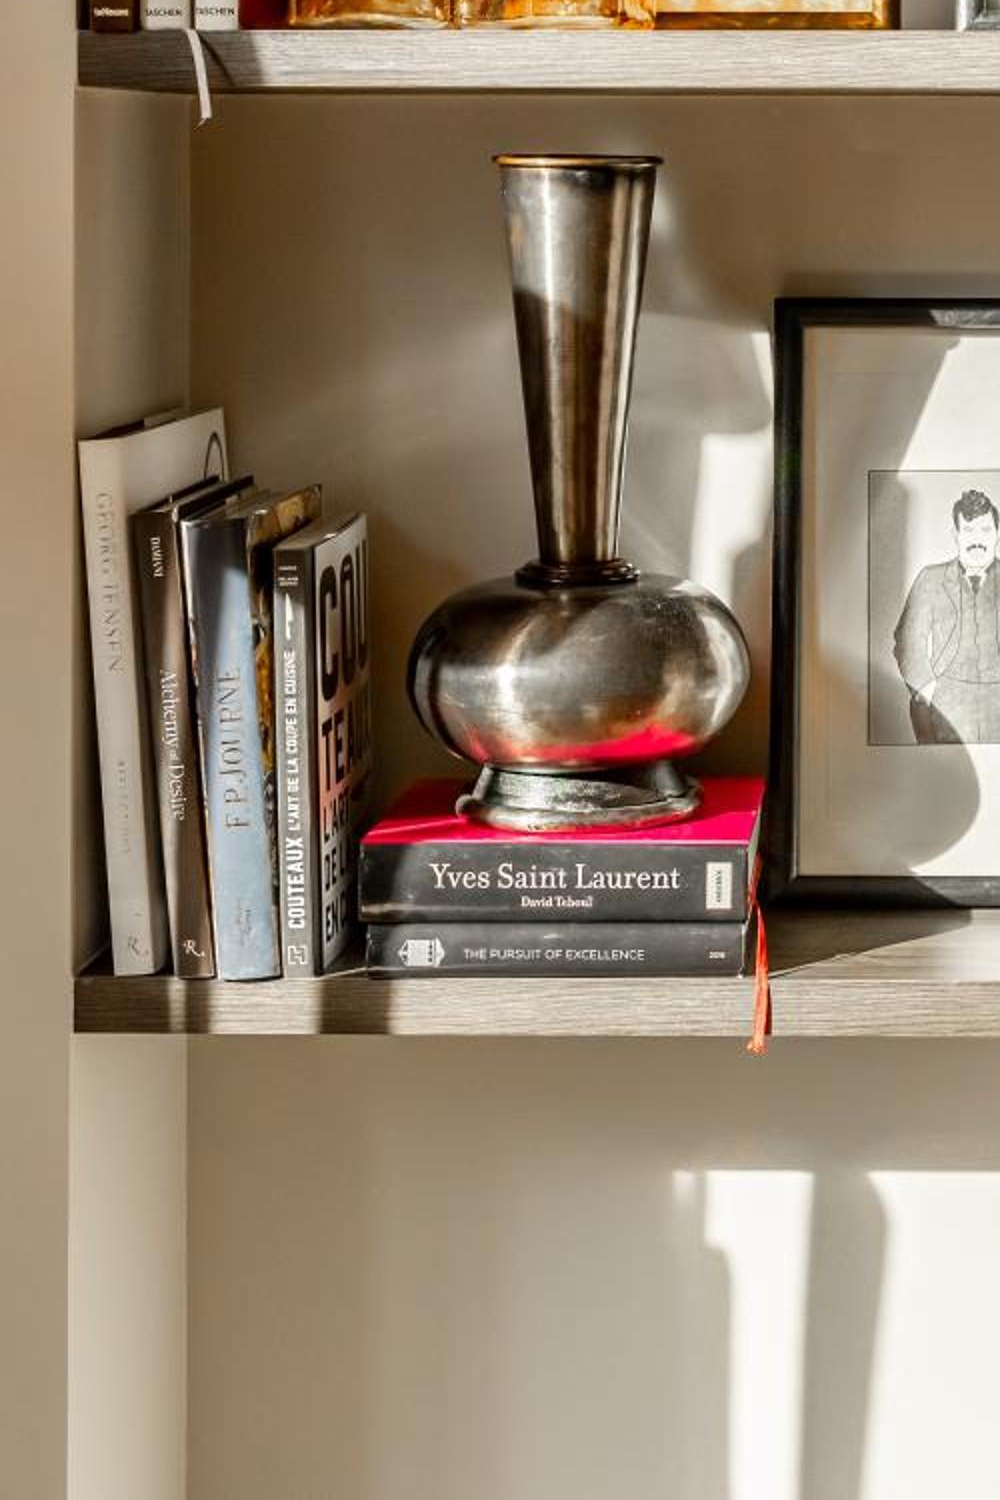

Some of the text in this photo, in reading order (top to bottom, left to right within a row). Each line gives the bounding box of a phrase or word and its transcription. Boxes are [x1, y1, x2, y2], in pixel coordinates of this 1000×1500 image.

[159, 669, 180, 751] Alchemy
[167, 765, 187, 820] Desire
[284, 650, 305, 929] COUTEAUX L'ART DE LA COUPE EN CUISINE
[430, 863, 680, 890] Yves Saint Laurent
[521, 896, 553, 907] David
[464, 948, 645, 961] THE PURSUIT OF EXCELLENCE
